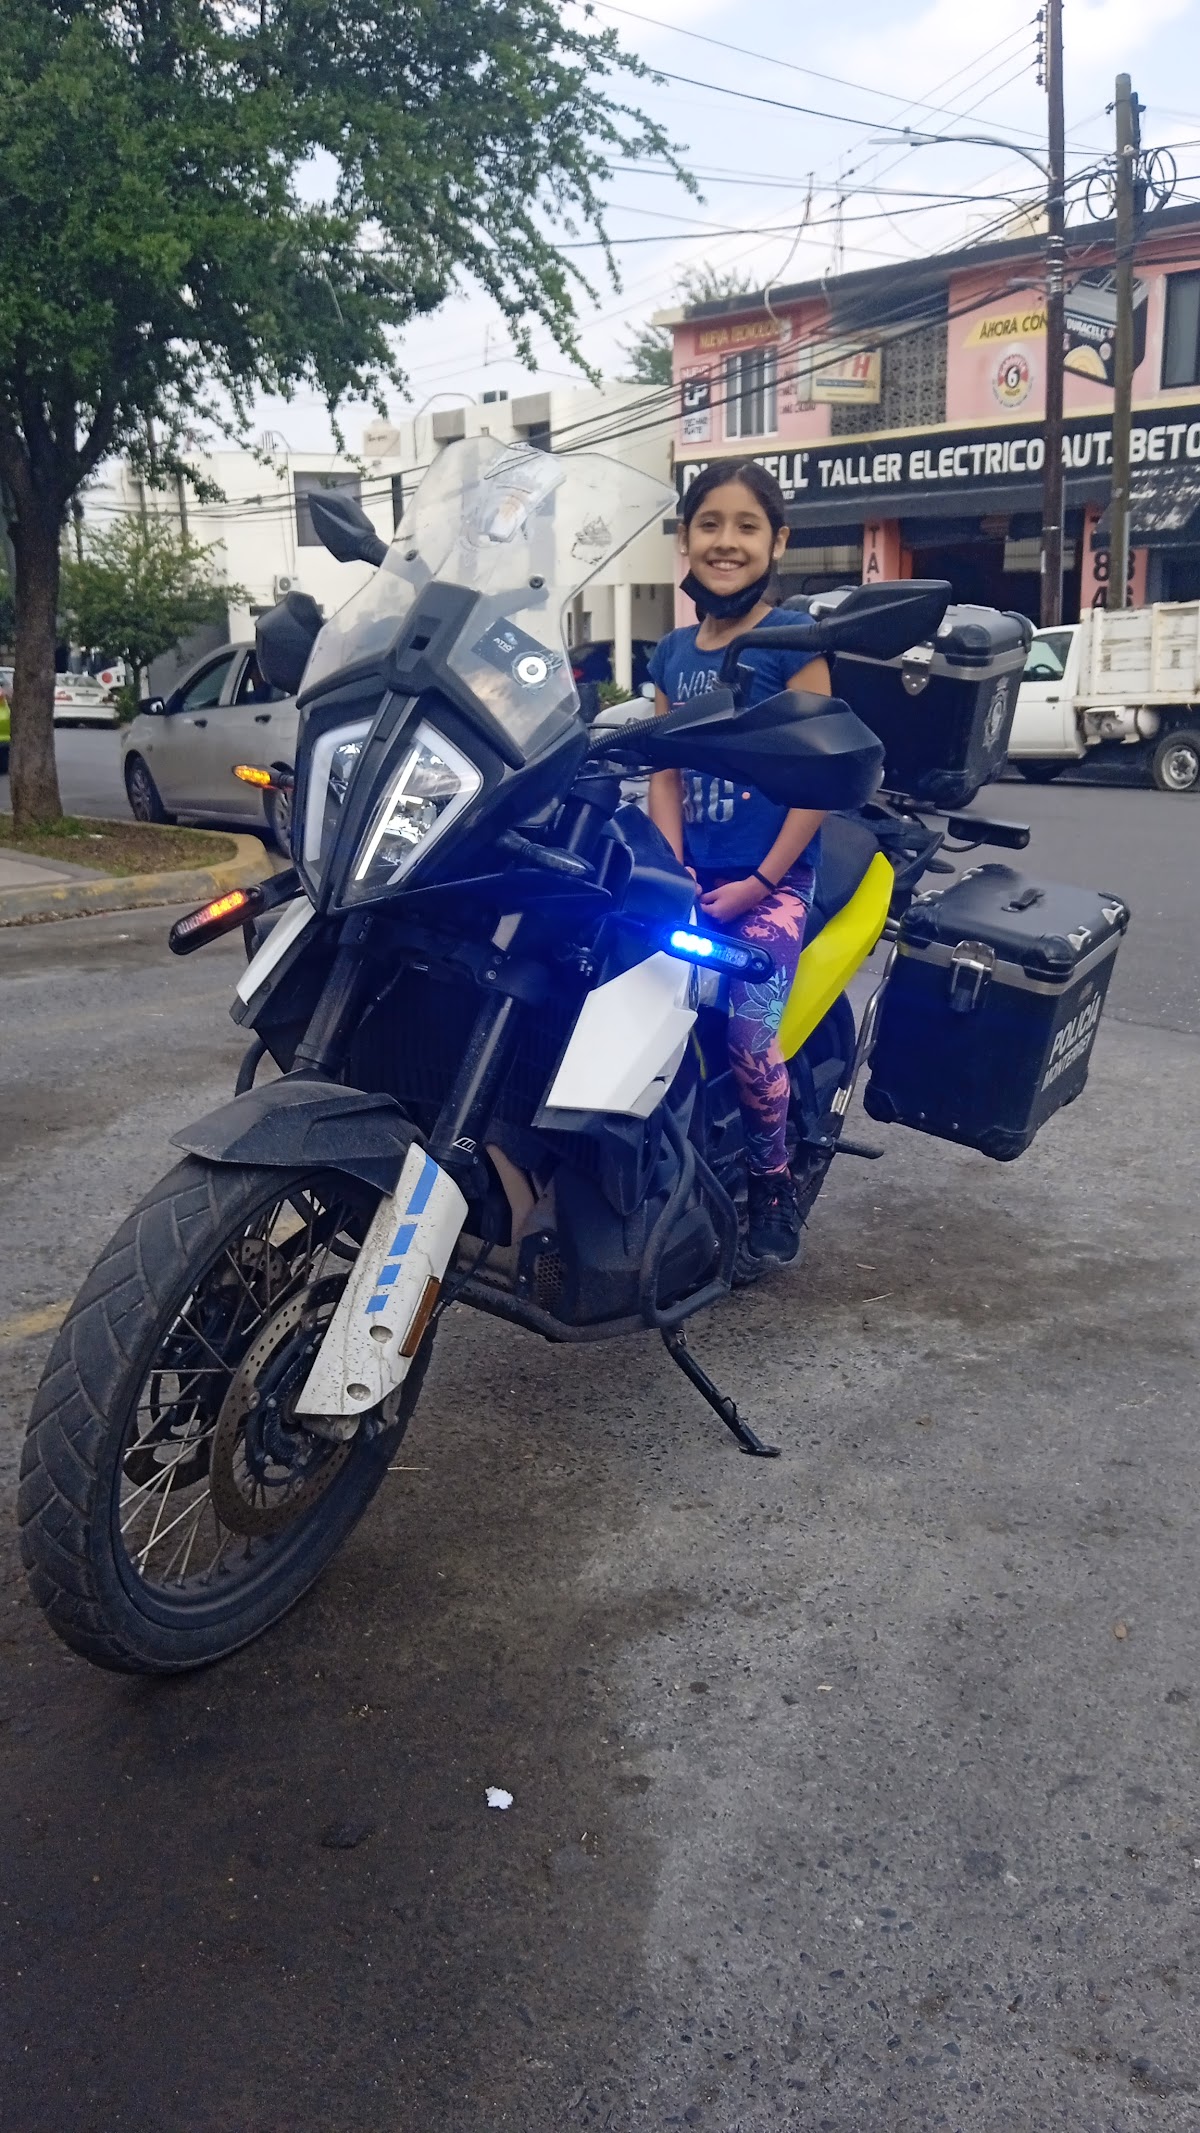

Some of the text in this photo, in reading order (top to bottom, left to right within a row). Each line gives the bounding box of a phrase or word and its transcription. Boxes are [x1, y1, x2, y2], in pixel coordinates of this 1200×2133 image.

[979, 313, 1048, 339] AHORA CON
[1006, 365, 1019, 388] 6
[818, 453, 903, 488] TALLER
[909, 438, 1046, 481] ELECTRICO
[1061, 431, 1114, 468] AUT.
[1128, 422, 1200, 464] BETO
